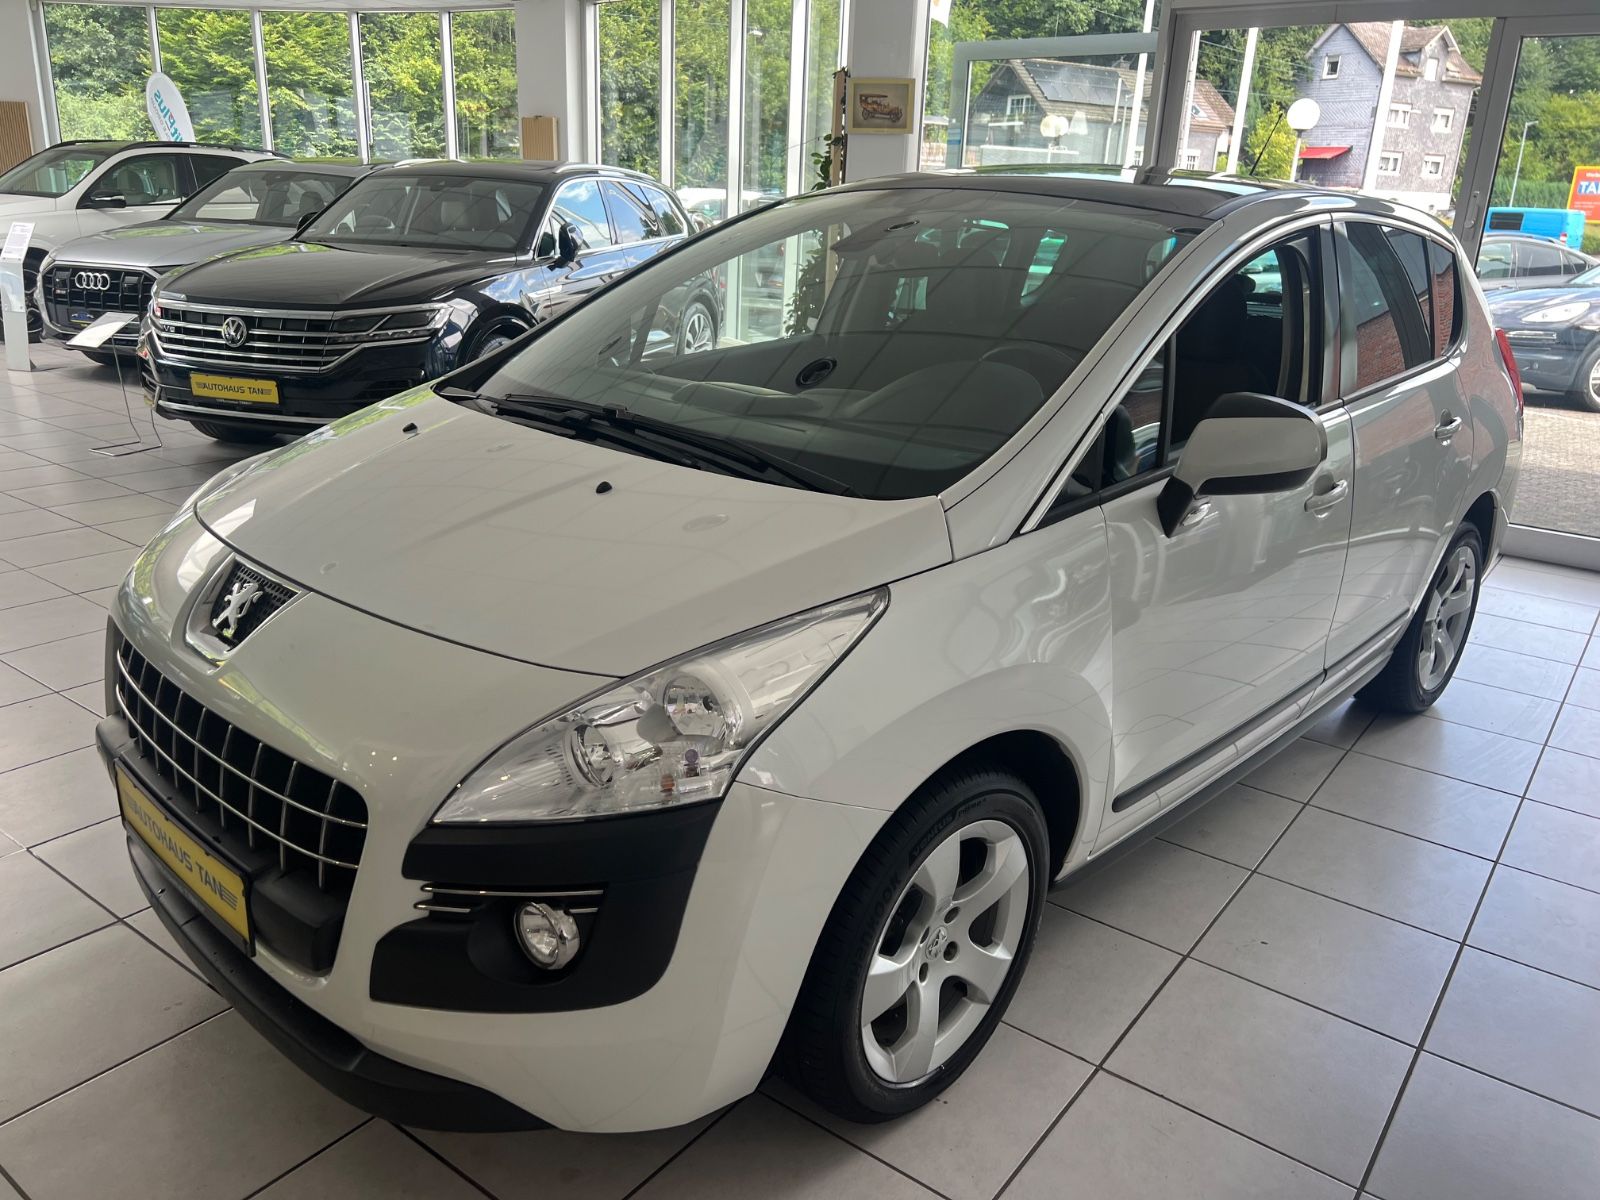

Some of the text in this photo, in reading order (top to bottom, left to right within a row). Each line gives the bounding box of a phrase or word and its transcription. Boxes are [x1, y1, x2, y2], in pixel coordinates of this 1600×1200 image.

[1578, 181, 1600, 195] TA
[202, 383, 264, 395] AUTOHAUS TAN
[135, 804, 224, 900] AUTOHAUS TAN
